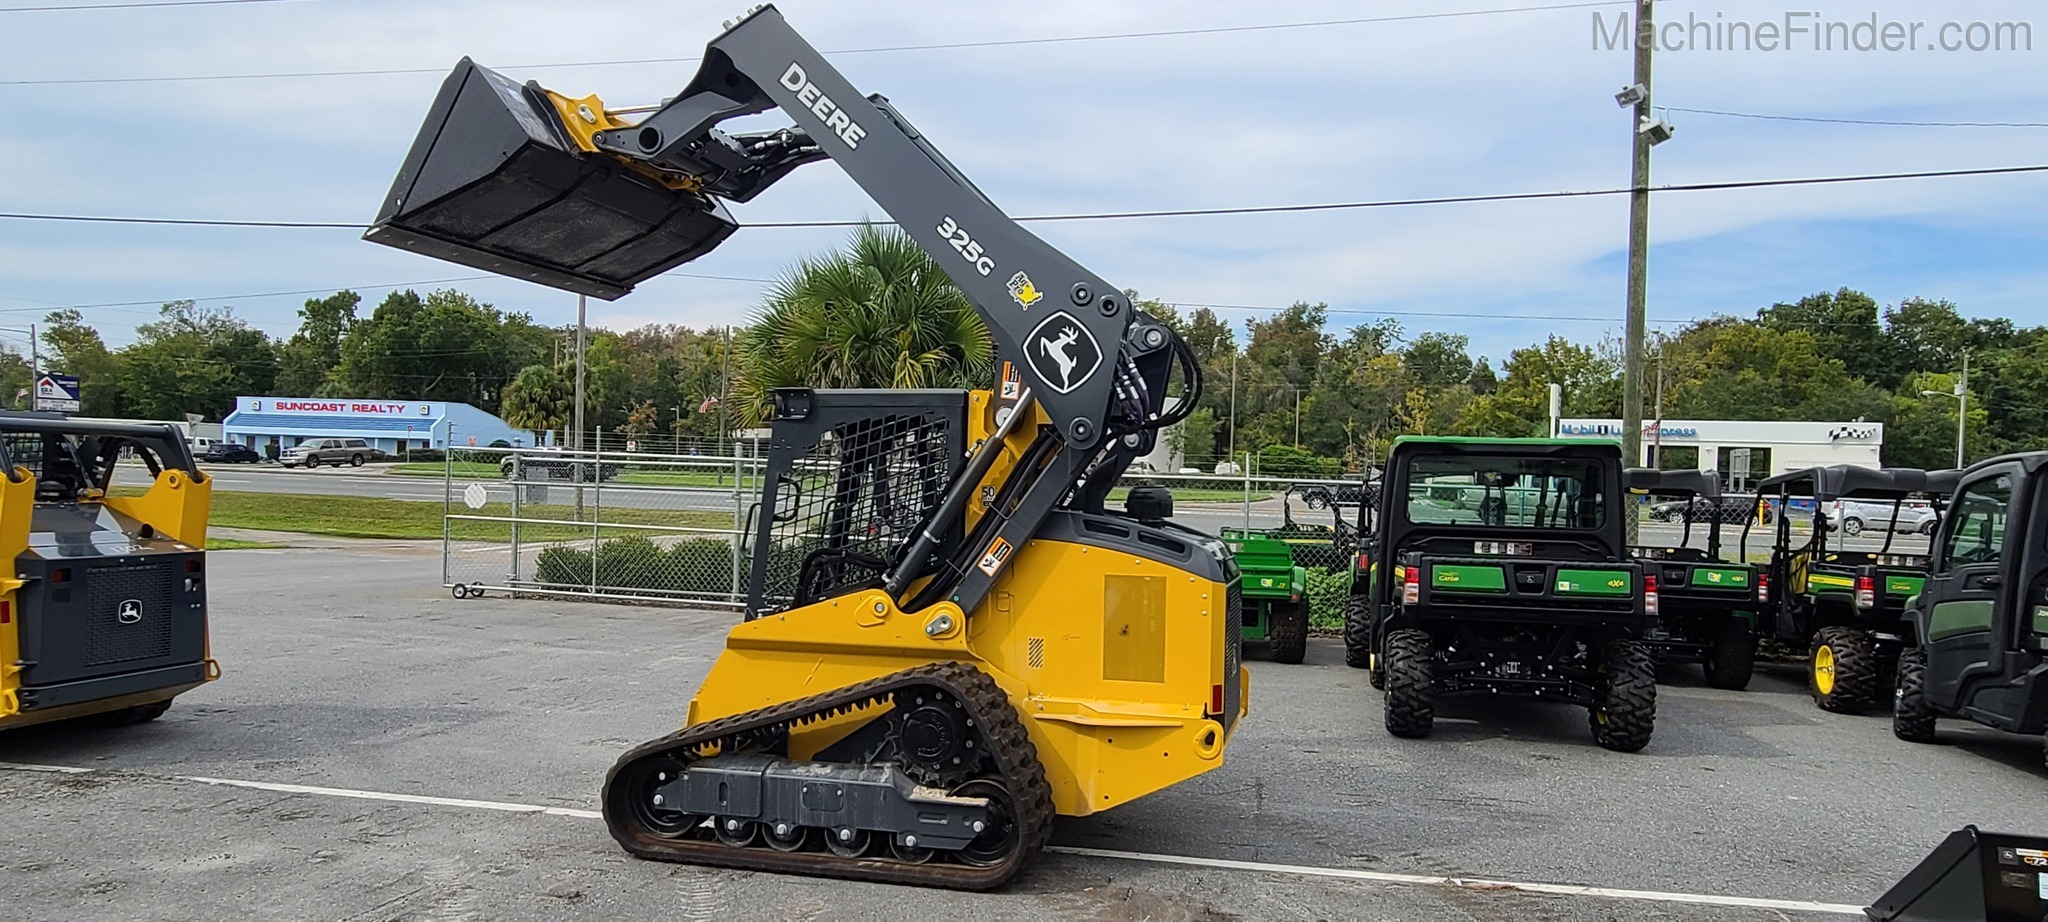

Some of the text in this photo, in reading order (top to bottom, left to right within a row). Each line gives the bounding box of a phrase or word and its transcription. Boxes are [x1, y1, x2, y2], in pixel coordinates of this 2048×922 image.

[779, 61, 867, 150] DEERE
[936, 215, 997, 277] 325G
[275, 402, 406, 413] SUNCOAST REALTY
[1561, 424, 1595, 435] Mobil
